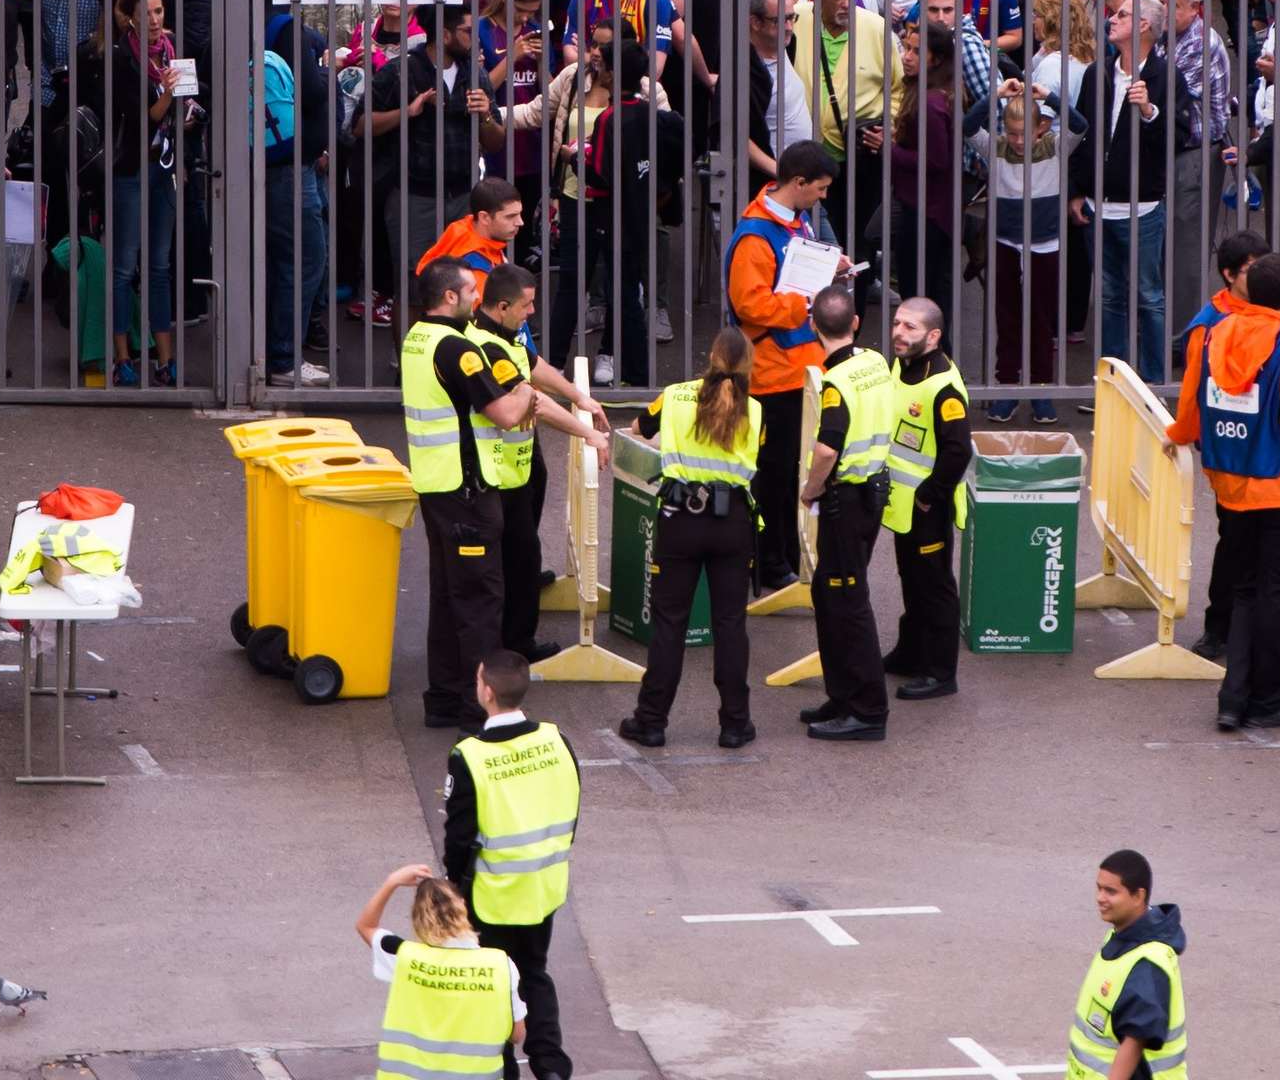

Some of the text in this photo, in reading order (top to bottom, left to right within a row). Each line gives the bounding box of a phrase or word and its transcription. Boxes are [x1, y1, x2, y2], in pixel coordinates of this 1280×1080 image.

[1216, 420, 1248, 440] 080
[484, 741, 556, 770] SEGURETAT
[410, 959, 495, 978] SEGURETAT
